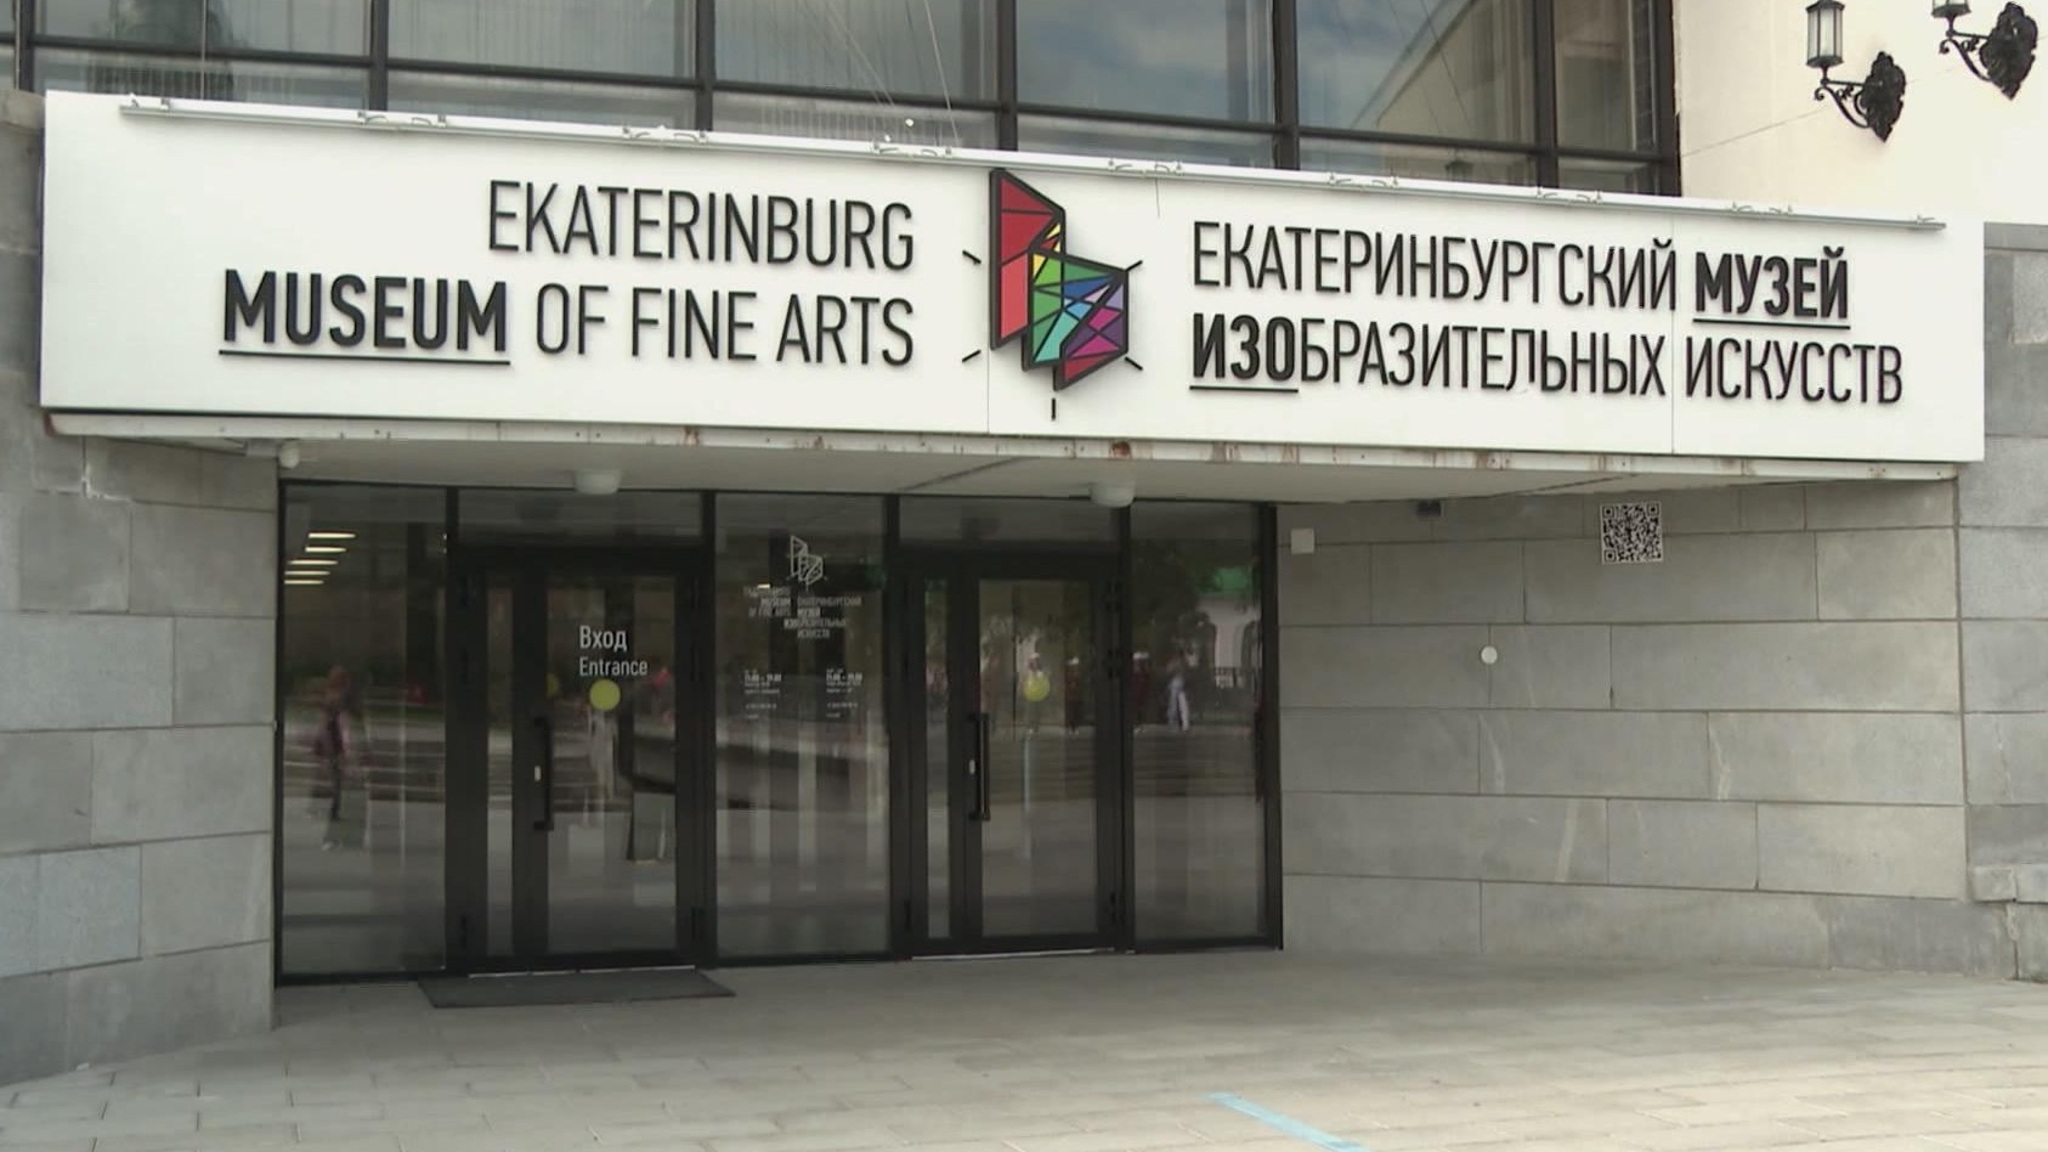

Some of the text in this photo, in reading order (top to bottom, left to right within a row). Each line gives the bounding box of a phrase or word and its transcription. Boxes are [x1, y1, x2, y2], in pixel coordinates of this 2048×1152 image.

[490, 180, 914, 268] EKATERINBURG
[1194, 221, 1849, 320] ЕКАТЕРИНБУРГСКИЙ МУЗЕЙ
[223, 269, 914, 367] MUSEUM OF FINE ARTS
[1193, 313, 1903, 404] ИЗОБРАЗИТЕЛЬНЫХ ИСКУССТВ
[579, 624, 628, 653] Вход
[579, 656, 648, 677] Entrance
